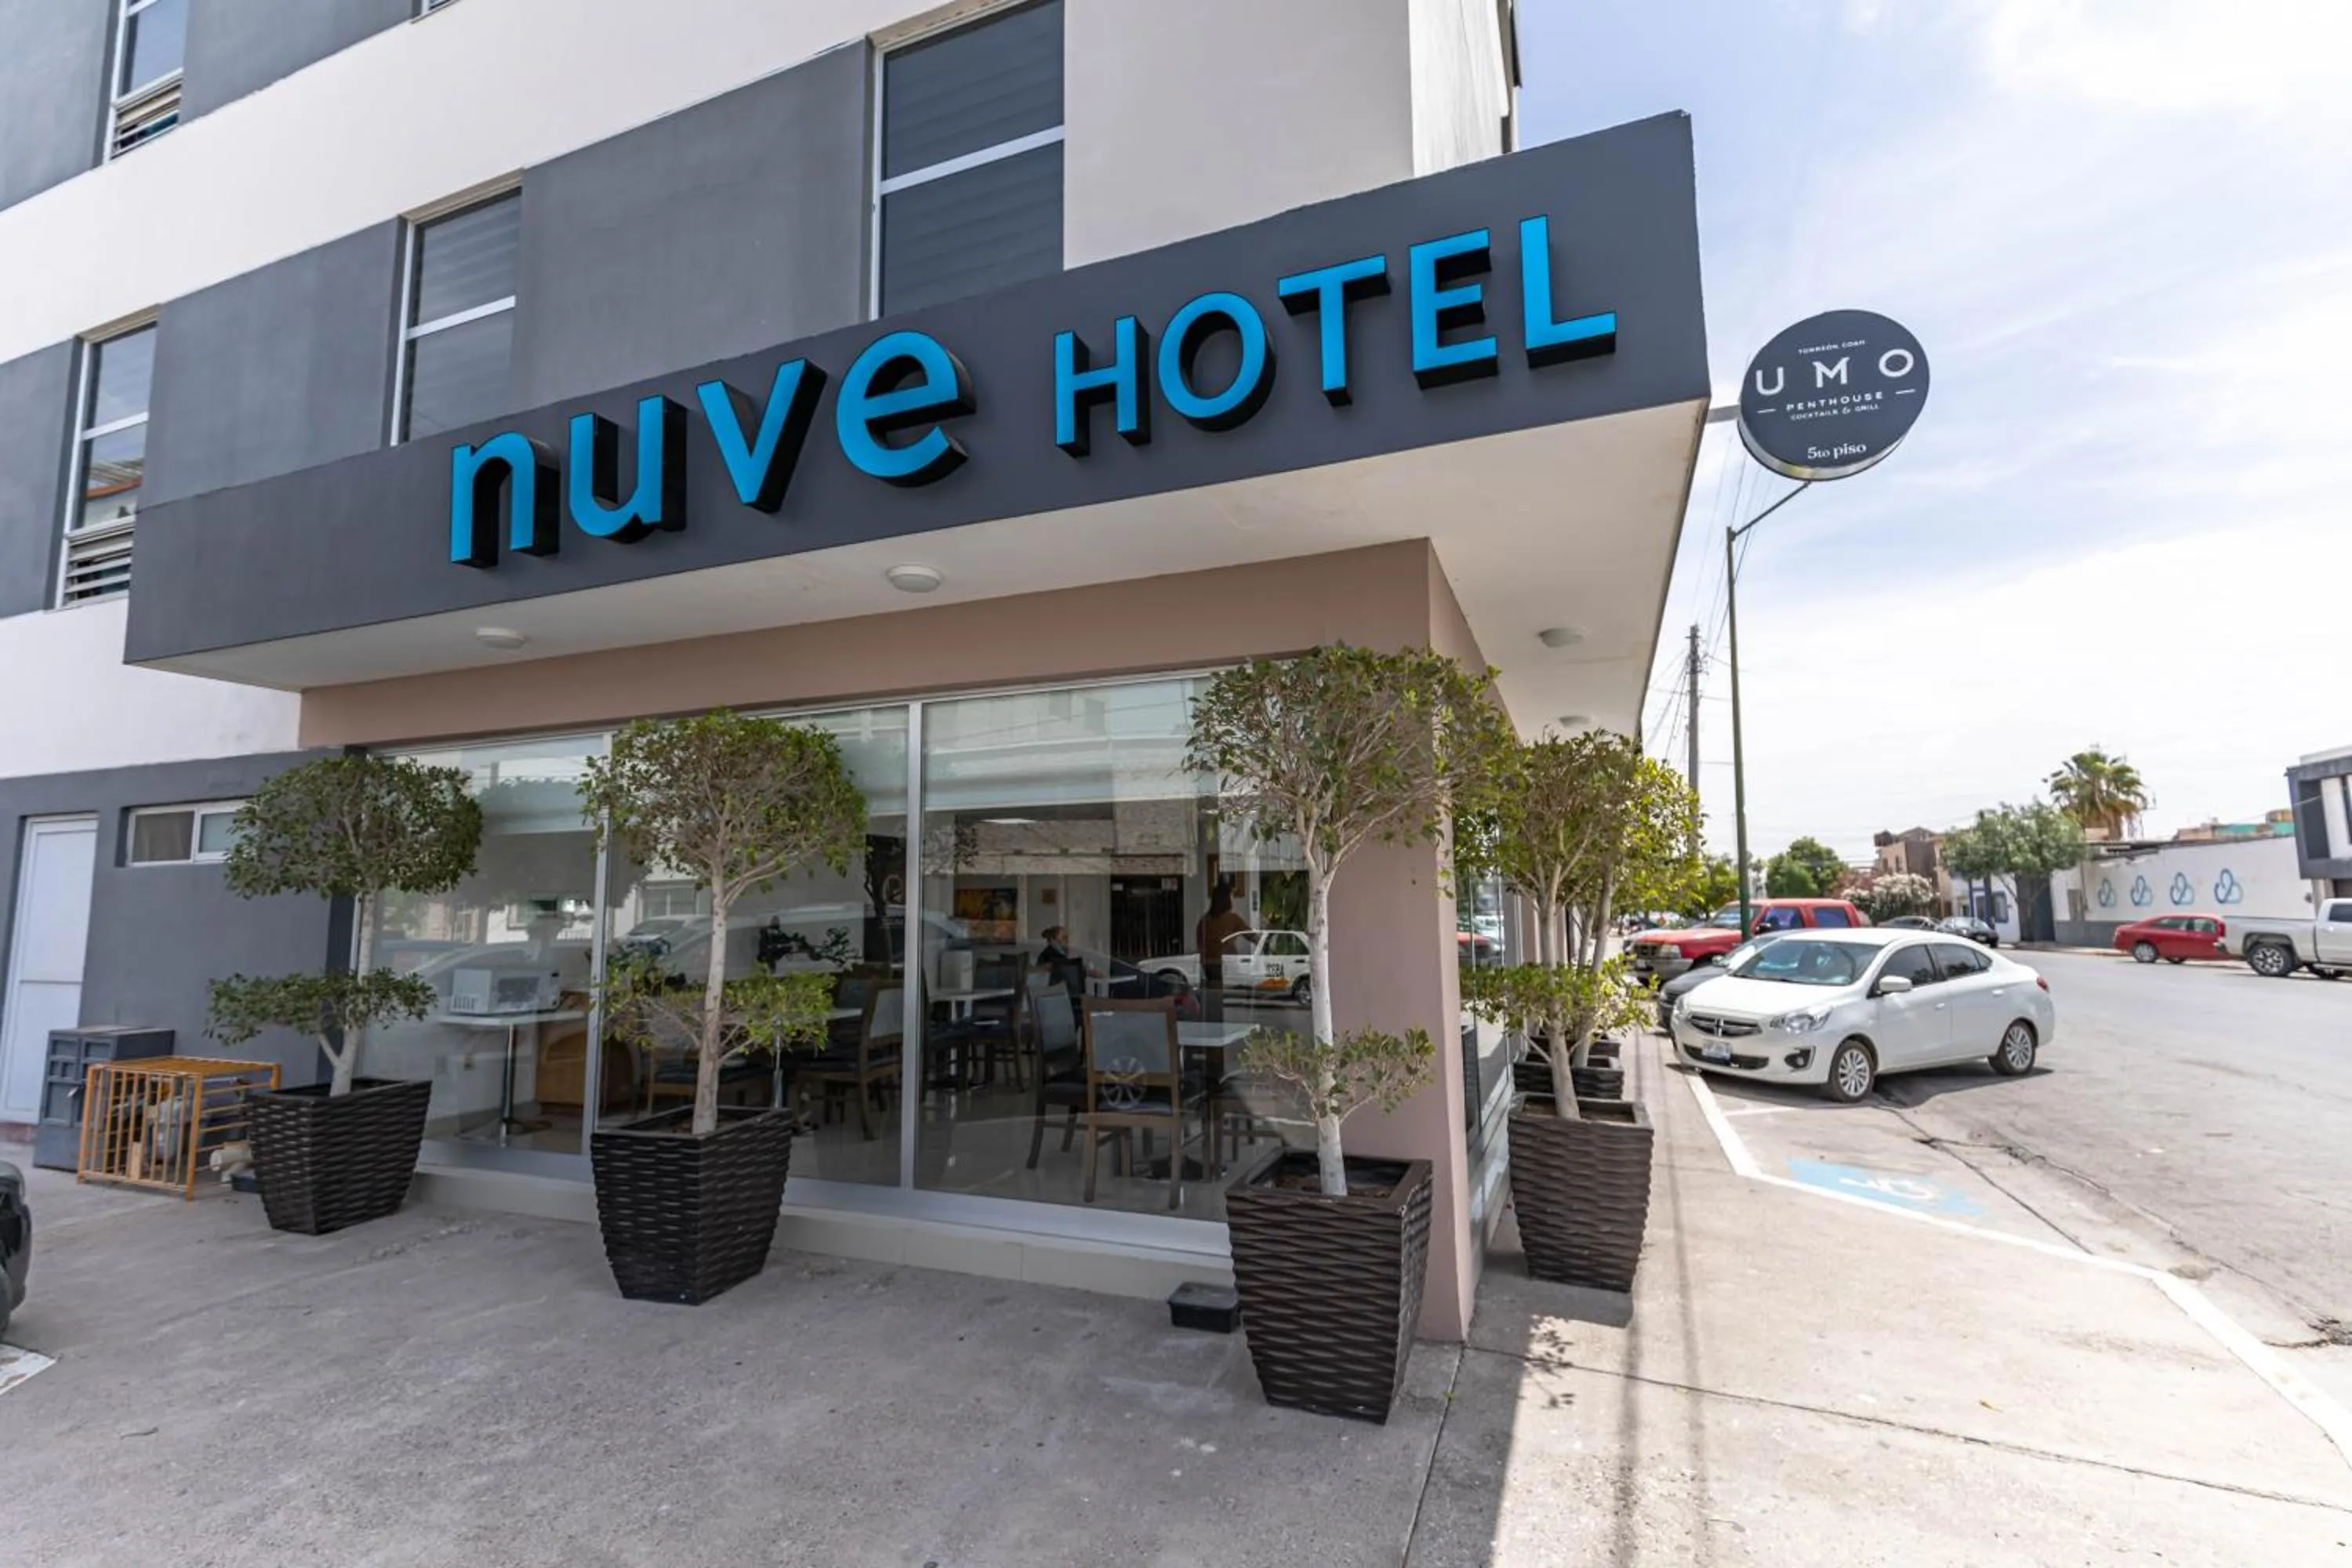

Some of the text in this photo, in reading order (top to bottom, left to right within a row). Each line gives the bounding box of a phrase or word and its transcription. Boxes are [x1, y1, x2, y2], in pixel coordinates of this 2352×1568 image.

[449, 215, 1618, 568] nuve HOTEL
[1786, 391, 1883, 412] PENTHOUSE
[1791, 408, 1838, 421] COCKTAILS
[1854, 404, 1879, 412] GRILL
[1807, 442, 1867, 460] 5to piso
